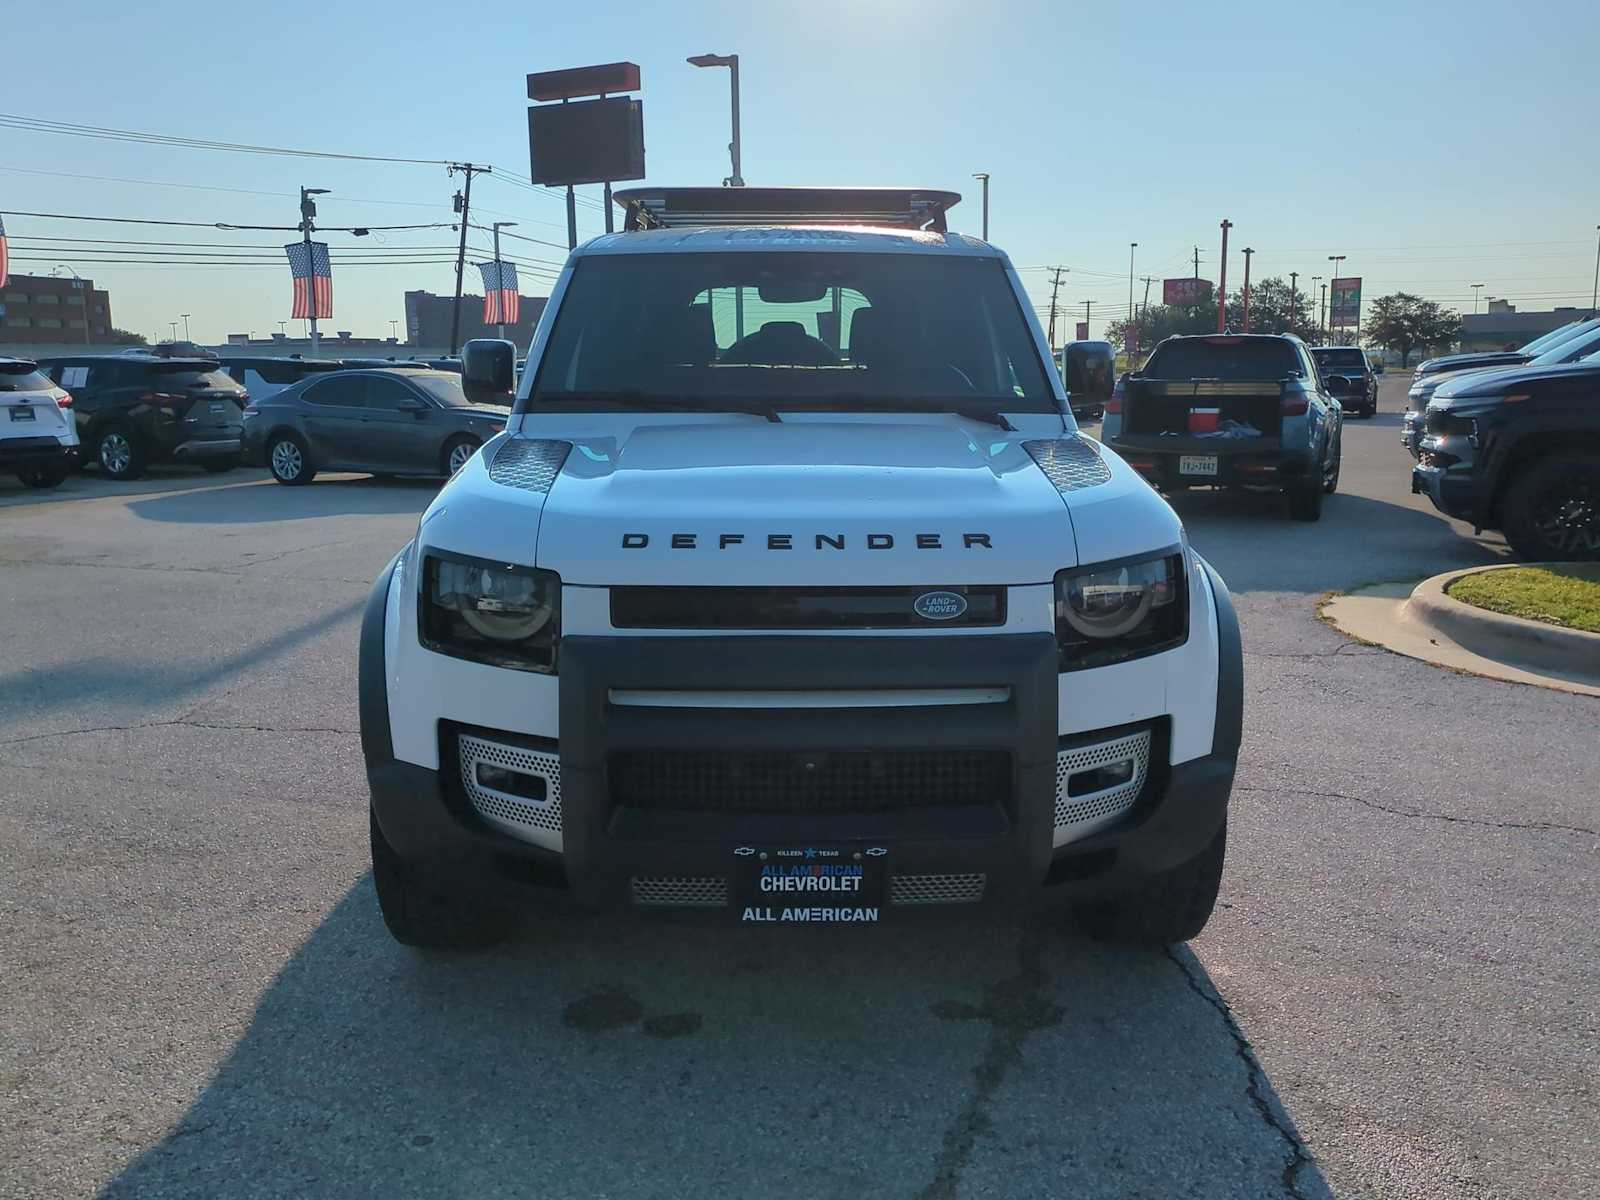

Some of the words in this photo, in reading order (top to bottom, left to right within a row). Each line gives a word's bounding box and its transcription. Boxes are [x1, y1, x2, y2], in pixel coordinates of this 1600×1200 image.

[622, 533, 993, 550] DEFENDER
[761, 865, 787, 876] ALL
[791, 865, 863, 876] AMERICAN
[760, 876, 863, 892] CHEVROLET
[742, 907, 777, 921] ALL
[781, 907, 878, 921] AMERICAN
